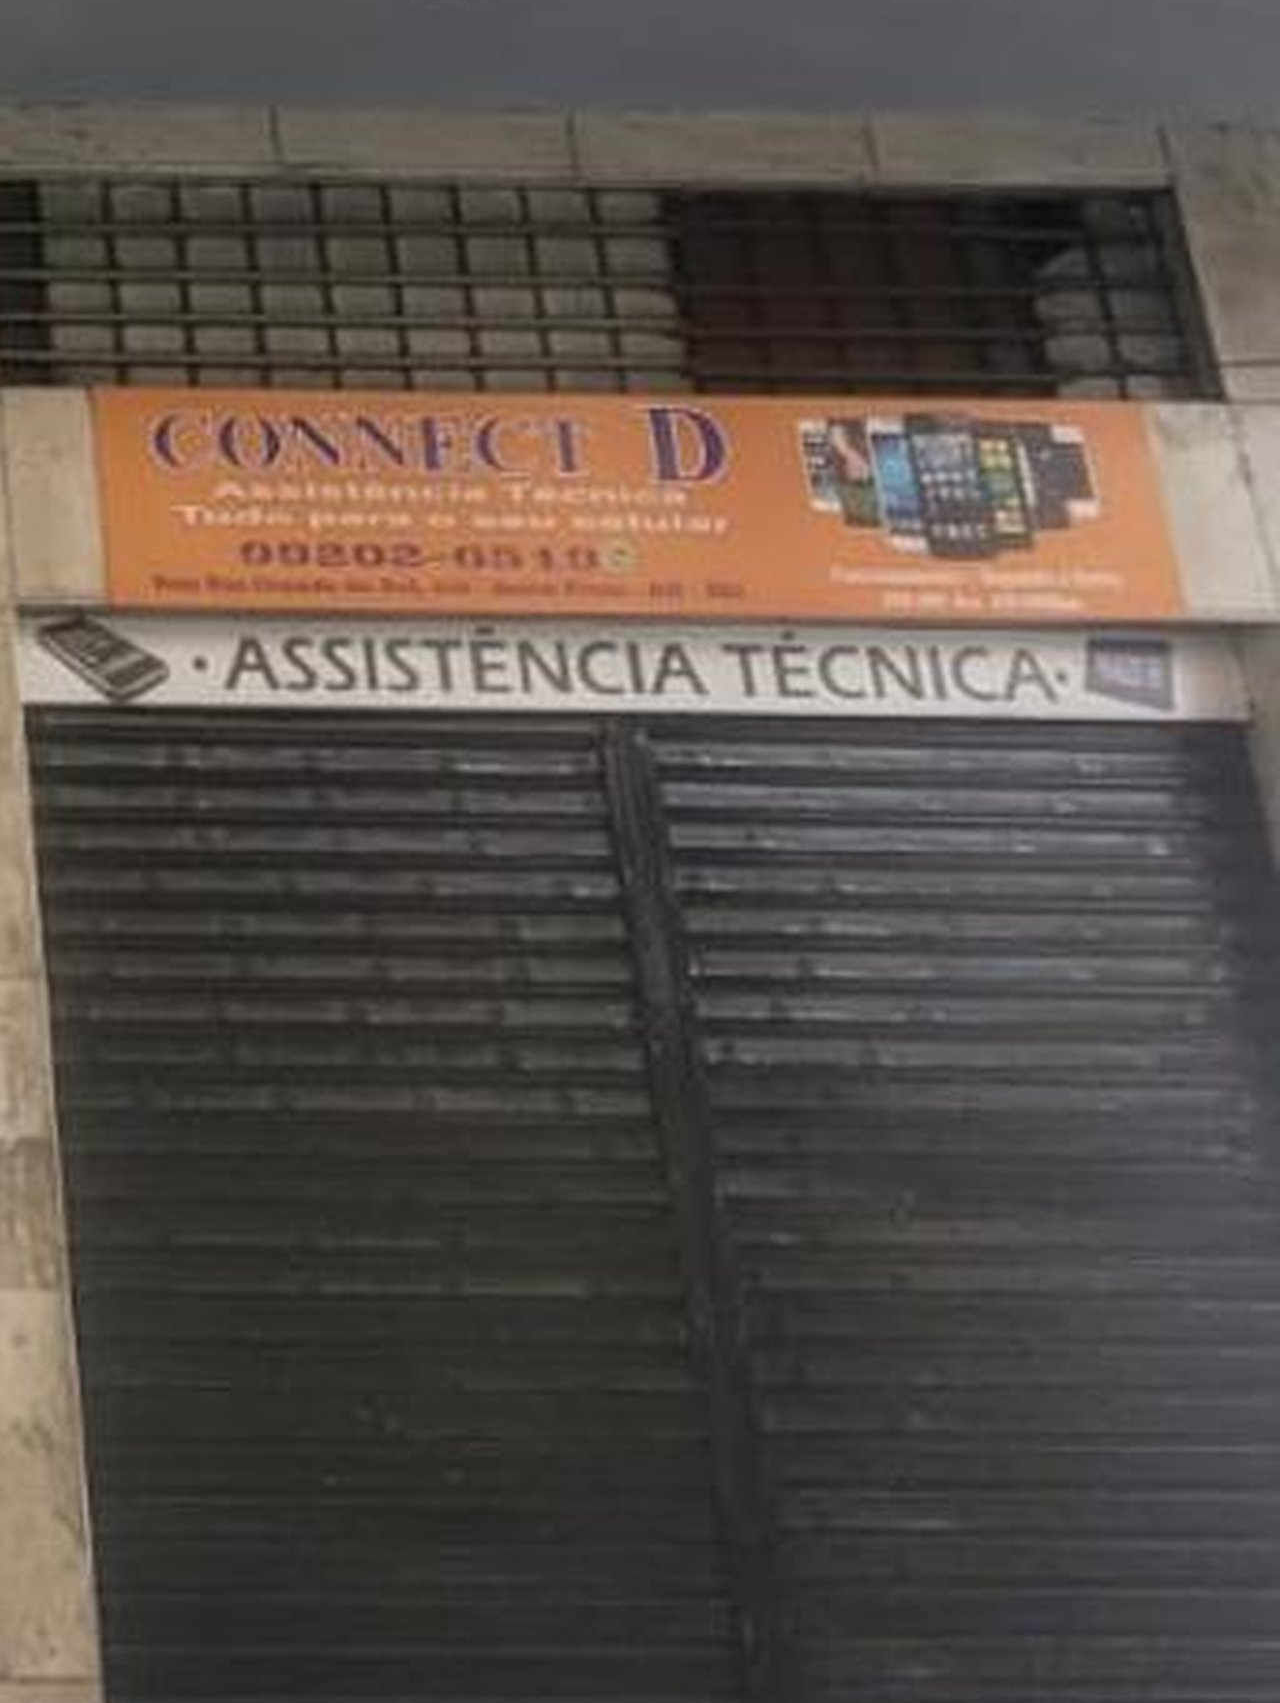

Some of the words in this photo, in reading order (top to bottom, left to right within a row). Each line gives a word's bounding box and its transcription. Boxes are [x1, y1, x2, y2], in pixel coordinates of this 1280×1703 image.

[149, 411, 588, 479] CONNECT
[639, 405, 730, 483] D
[224, 628, 707, 697] ASSISTÊNCIA
[722, 633, 1059, 704] TÉCNICA
